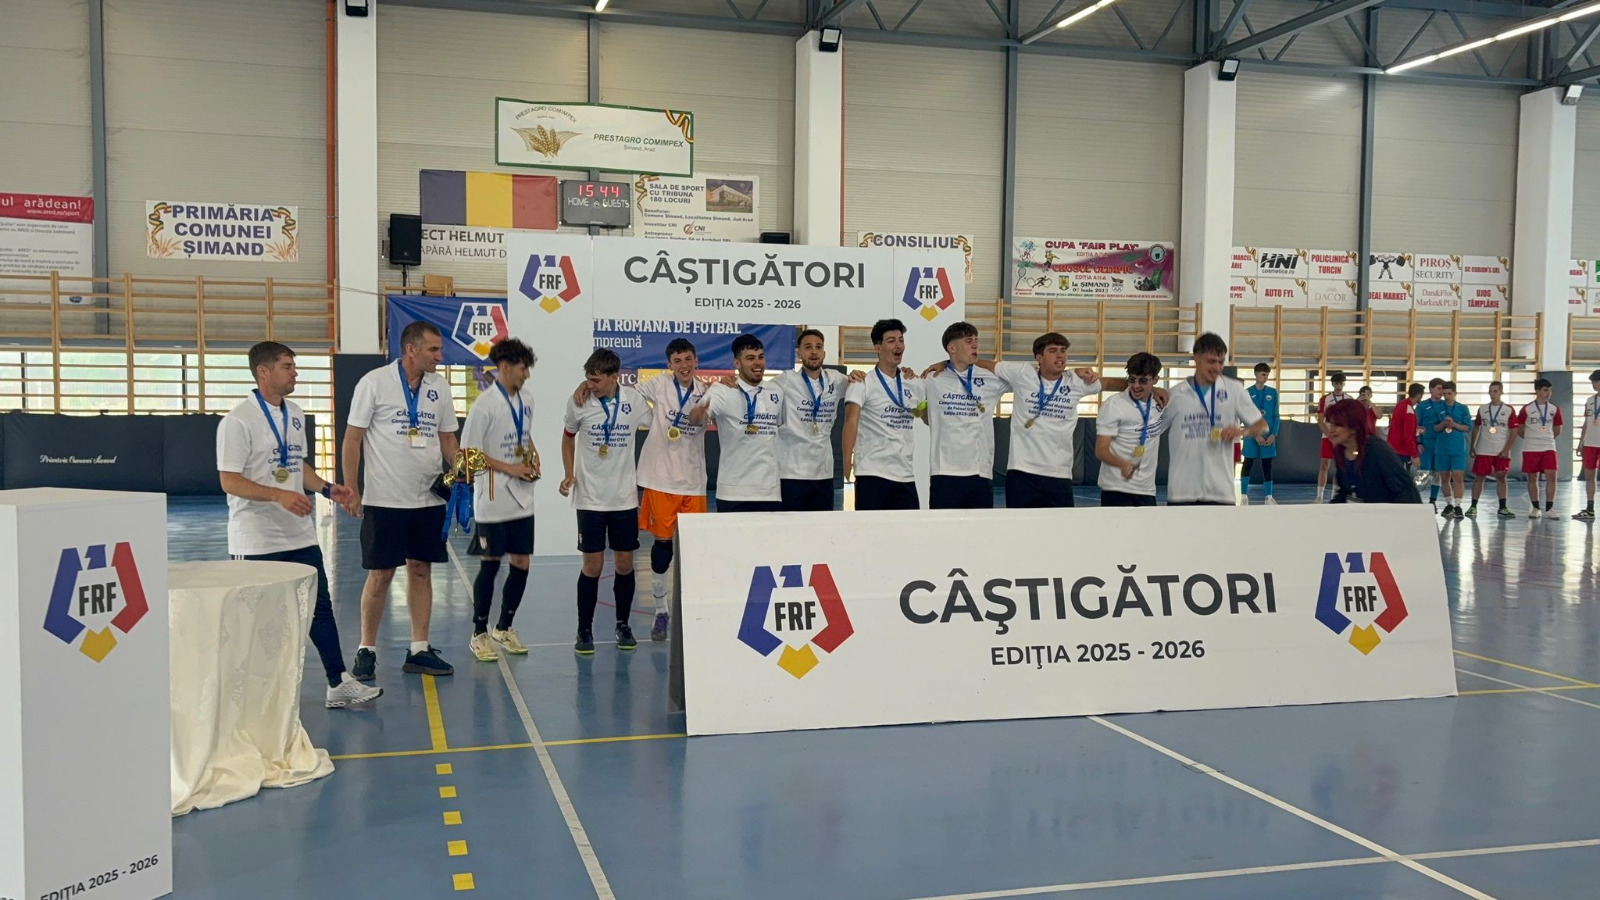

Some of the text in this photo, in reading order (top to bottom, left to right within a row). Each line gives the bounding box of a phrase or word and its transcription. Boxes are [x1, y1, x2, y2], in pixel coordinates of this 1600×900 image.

[593, 133, 684, 148] PRESTAGRO COMIMPEX
[649, 183, 669, 191] SALA
[661, 190, 694, 198] TRIBUNA
[24, 197, 82, 211] arădean!
[567, 197, 631, 208] HOME GUESTS
[172, 203, 275, 222] PRIMĂRIA
[174, 222, 272, 239] COMUNEI
[449, 231, 504, 244] HELMUT
[183, 239, 264, 259] ȘIMAND
[873, 234, 959, 249] CONSILIUL
[1044, 240, 1076, 250] CUPA
[454, 247, 497, 258] HELMUT
[1311, 254, 1350, 264] POLICLINICA
[1260, 252, 1299, 270] HNI
[623, 250, 865, 294] CÂȘTIGĂTORI
[1318, 265, 1342, 275] TURCIN
[1415, 270, 1455, 279] SECURITY
[539, 273, 562, 290] FRF
[919, 284, 939, 299] FRF
[1264, 288, 1294, 299] AUTO FYL
[1314, 292, 1348, 303] DACOR
[1383, 291, 1407, 301] MARKET
[736, 298, 764, 308] 2025
[774, 298, 802, 310] 2026
[1416, 298, 1458, 307] Market&PUB
[472, 321, 493, 337] FRF
[673, 320, 691, 334] DE
[692, 321, 742, 335] FOTBAL
[79, 581, 117, 617] FRF
[1343, 585, 1377, 613] FRF
[774, 601, 816, 632] FRF
[1076, 642, 1131, 662] 2025
[1151, 639, 1206, 660] 2026
[88, 869, 119, 890] 2025
[129, 854, 159, 874] 2026
